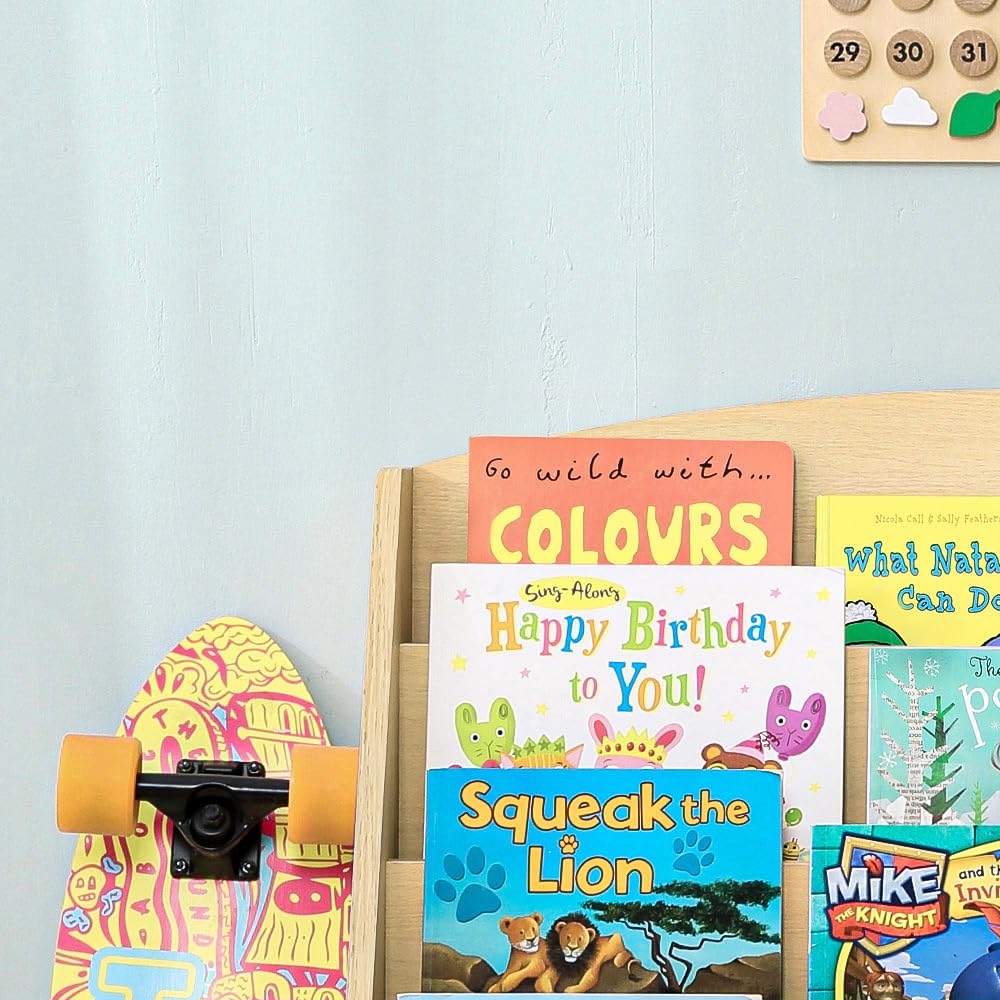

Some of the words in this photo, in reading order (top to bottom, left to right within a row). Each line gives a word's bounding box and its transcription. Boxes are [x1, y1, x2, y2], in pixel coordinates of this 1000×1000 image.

[830, 42, 860, 62] 29
[893, 43, 923, 62] 30
[961, 43, 987, 62] 31
[486, 457, 511, 480] Go
[537, 452, 627, 482] wild
[655, 454, 771, 480] with...
[490, 502, 768, 565] COLOURS
[874, 514, 903, 524] Nicola
[907, 514, 924, 524] Call
[937, 514, 960, 527] Sally
[844, 541, 919, 578] What
[524, 581, 621, 602] Sing-Along
[897, 584, 955, 613] Can
[485, 601, 609, 657] Happy
[622, 601, 792, 657] Birthday
[568, 672, 598, 702] to
[609, 661, 706, 712] You!
[458, 780, 676, 845] Squeak
[681, 790, 750, 825] the
[527, 834, 655, 895] Lion
[958, 865, 985, 879] and
[834, 907, 856, 924] THE
[855, 908, 937, 929] KNIGHT
